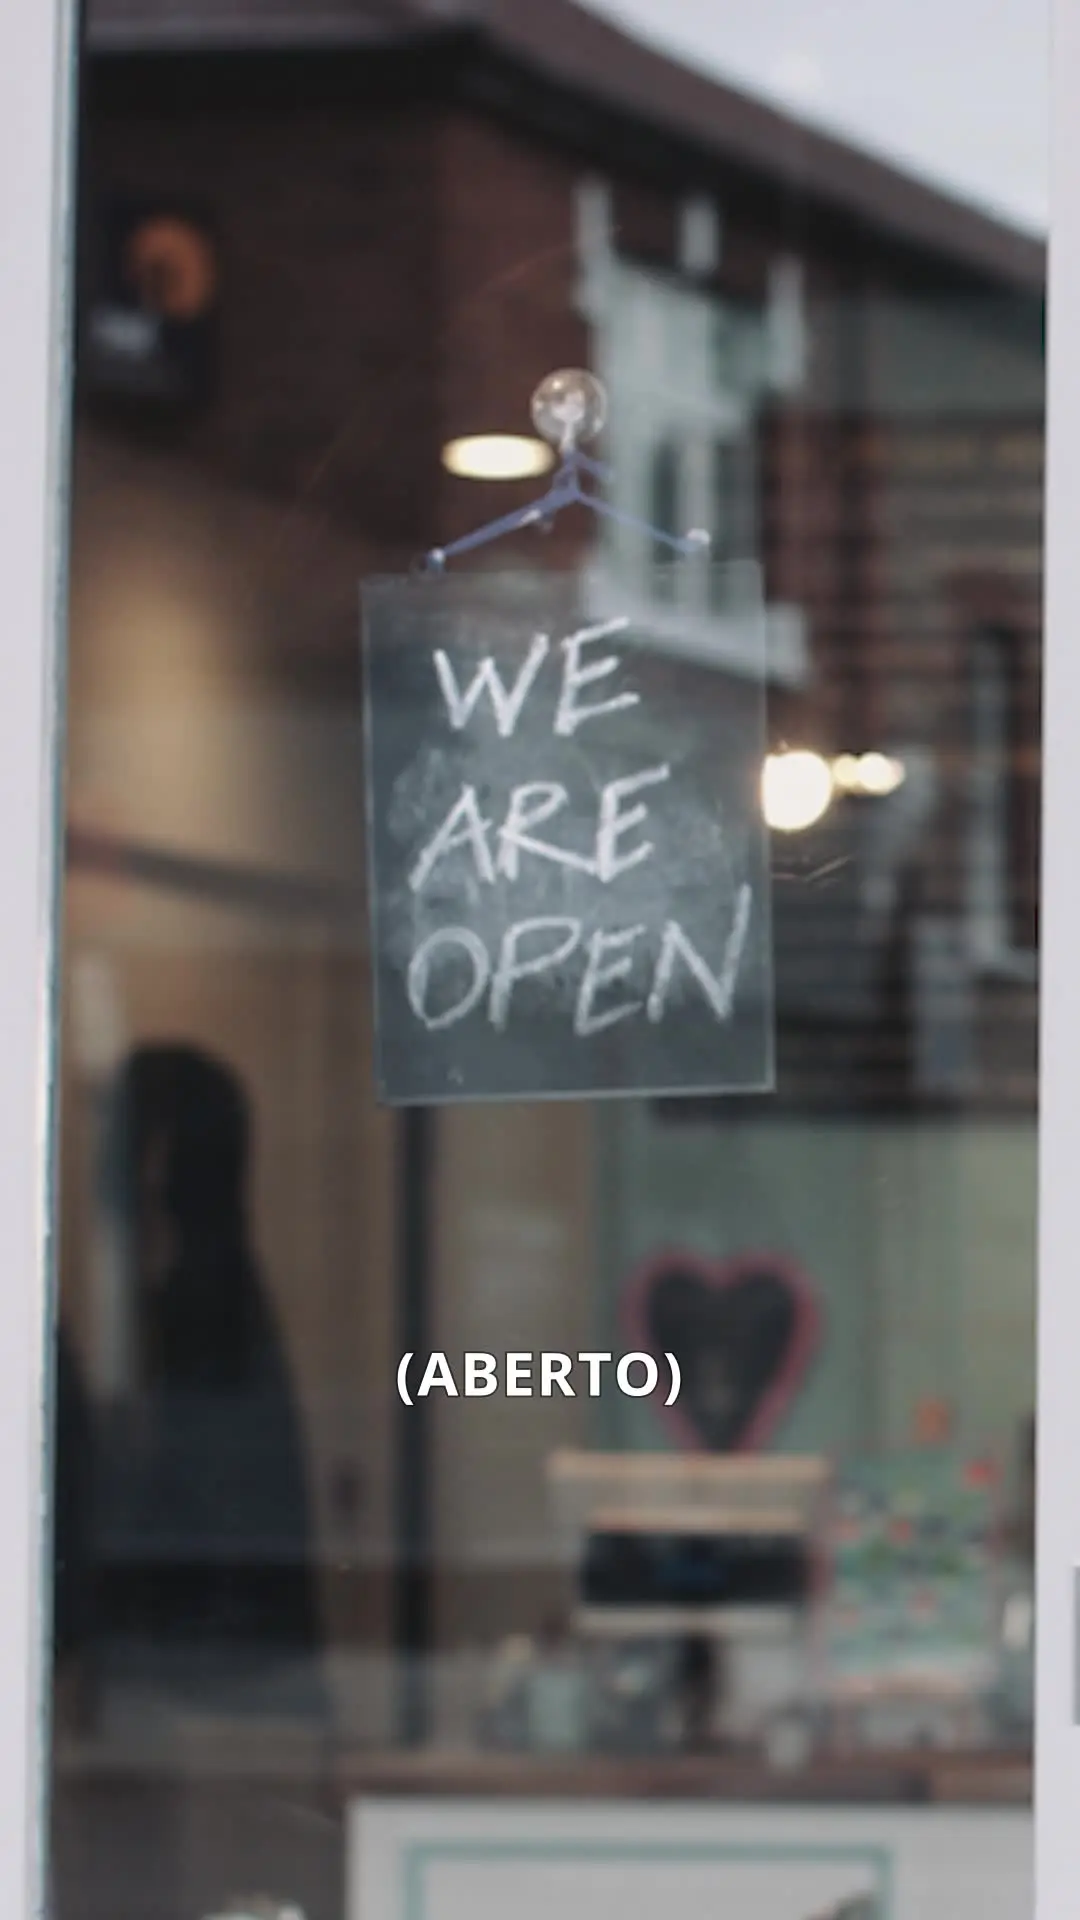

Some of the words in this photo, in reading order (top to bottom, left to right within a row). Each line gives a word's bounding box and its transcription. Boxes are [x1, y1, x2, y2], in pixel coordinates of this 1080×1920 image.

[432, 616, 641, 737] WE
[408, 762, 670, 892] ARE
[407, 883, 752, 1037] OPEN
